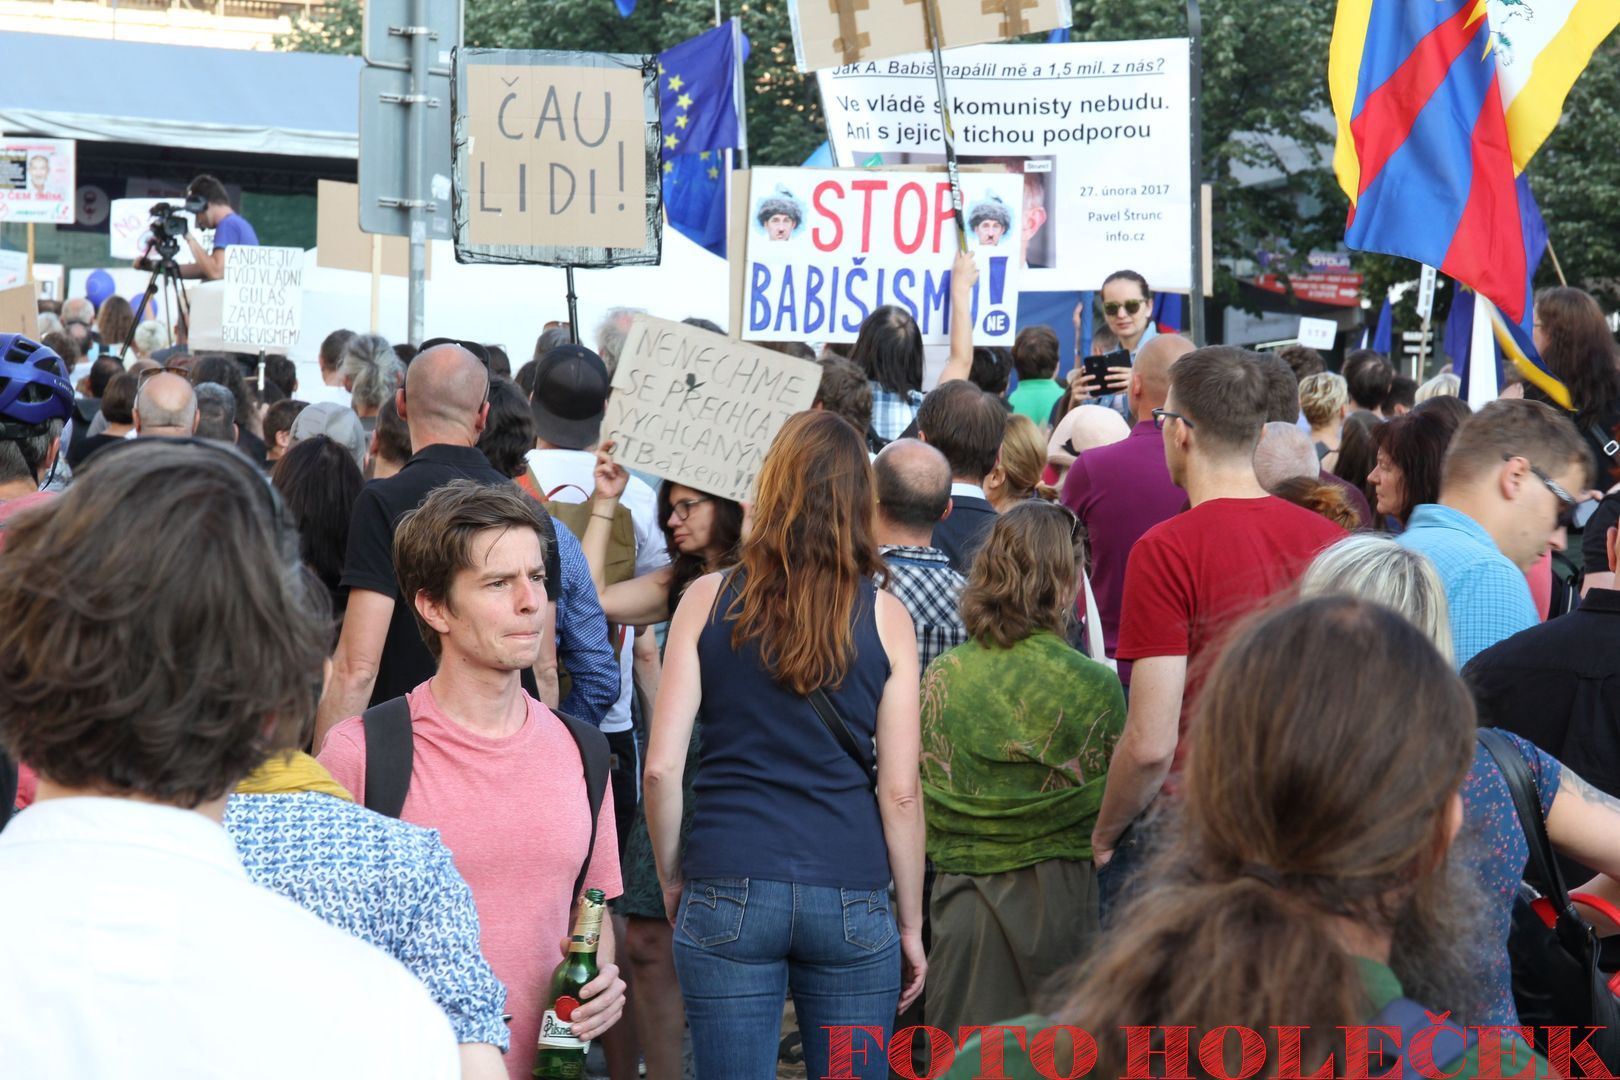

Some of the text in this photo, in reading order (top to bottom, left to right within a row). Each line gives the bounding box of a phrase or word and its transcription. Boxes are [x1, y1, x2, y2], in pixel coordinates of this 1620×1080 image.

[865, 61, 881, 74] A.
[888, 61, 936, 75] Babiš
[1002, 63, 1027, 77] mě
[1033, 67, 1041, 76] a
[1049, 62, 1072, 78] 1,5
[1077, 61, 1105, 75] mil.
[1112, 63, 1120, 73] z
[1125, 57, 1165, 73] nás?
[498, 76, 611, 148] ČAU
[837, 96, 860, 112] Ve
[867, 94, 925, 113] vládě
[953, 97, 1072, 119] komunisty
[1080, 92, 1169, 113] nebudu.
[847, 121, 1151, 147] Ani s jejic tichou podporou
[480, 141, 625, 215] LIDI!
[1080, 184, 1170, 197] 27. února 2017
[811, 180, 965, 255] STOP
[1088, 208, 1163, 222] Pavel Štrunc
[1106, 231, 1145, 242] info.cz
[986, 314, 1006, 332] NE
[635, 328, 806, 407] NENECHME
[622, 368, 656, 404] SE
[543, 1015, 573, 1037] Pilsne
